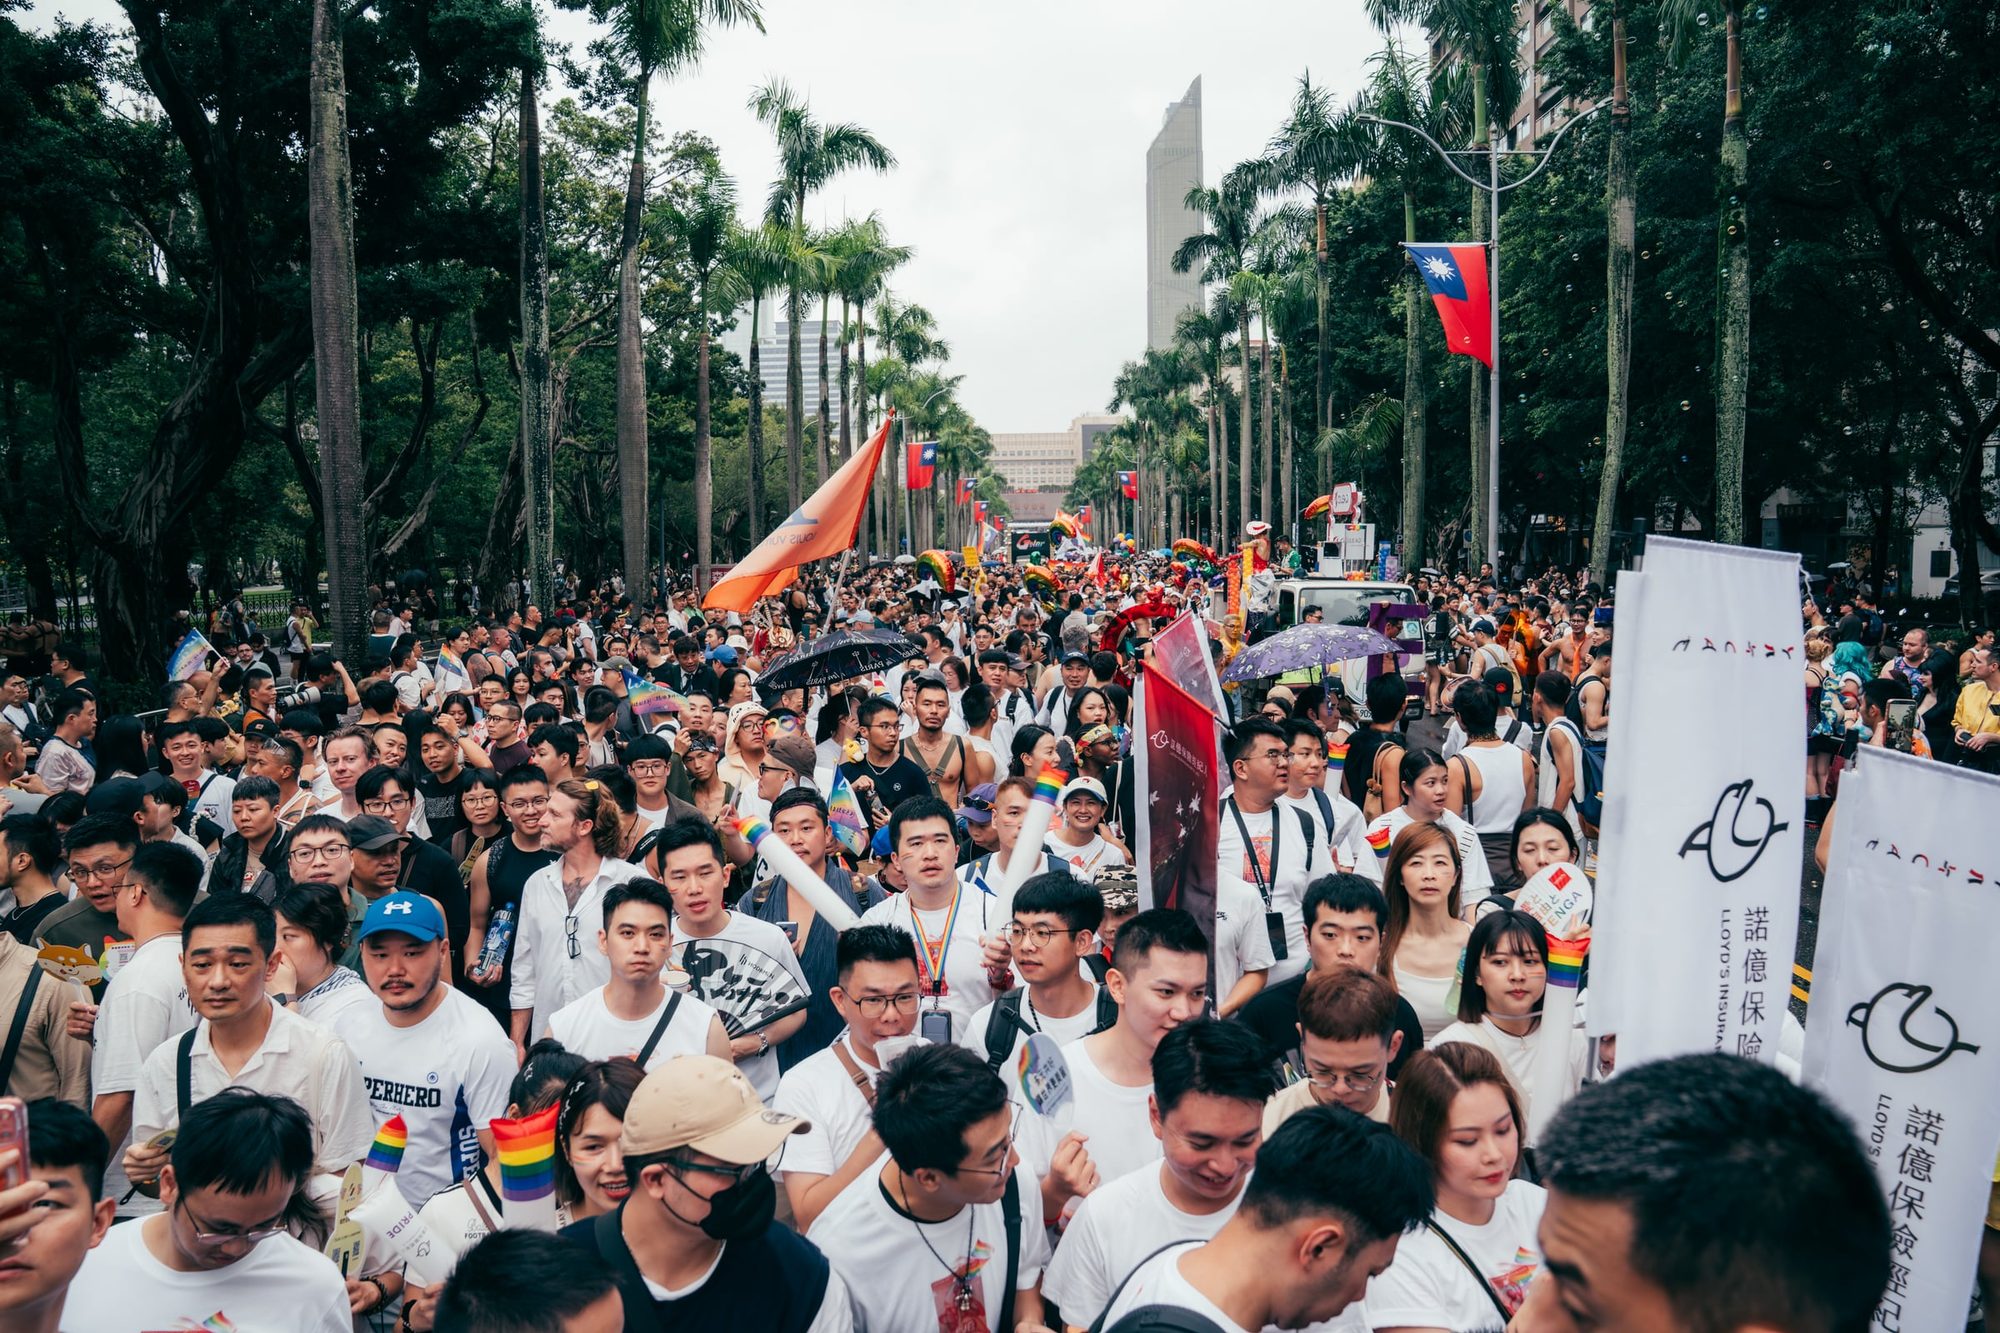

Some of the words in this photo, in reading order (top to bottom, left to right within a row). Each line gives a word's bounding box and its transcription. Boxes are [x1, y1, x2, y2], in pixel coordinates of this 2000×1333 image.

[1719, 908, 1731, 979] LLOYD'S
[1737, 906, 1770, 1059] 諾億保險
[386, 1210, 414, 1239] PRIDE
